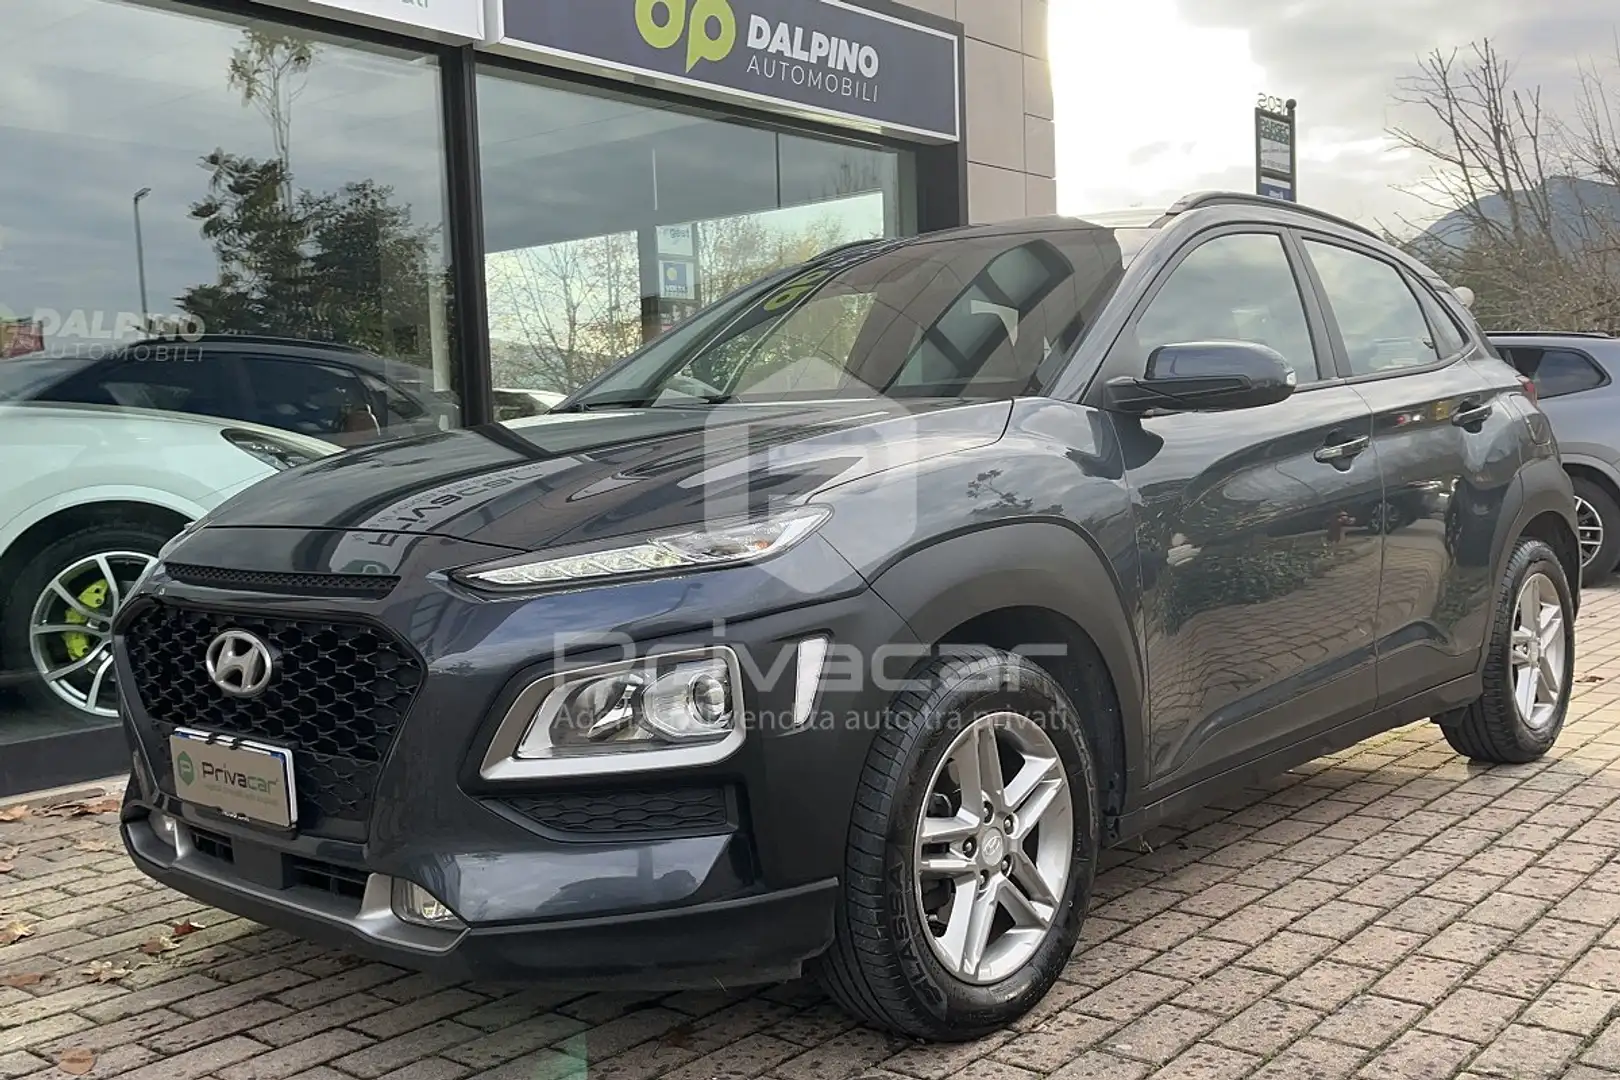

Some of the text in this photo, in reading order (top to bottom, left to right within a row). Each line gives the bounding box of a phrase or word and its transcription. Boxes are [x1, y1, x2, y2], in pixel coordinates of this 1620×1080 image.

[747, 14, 879, 78] DALPINO
[746, 55, 878, 103] AUTOMOBILI
[31, 307, 206, 342] DALPINO
[201, 761, 279, 795] Privacar
